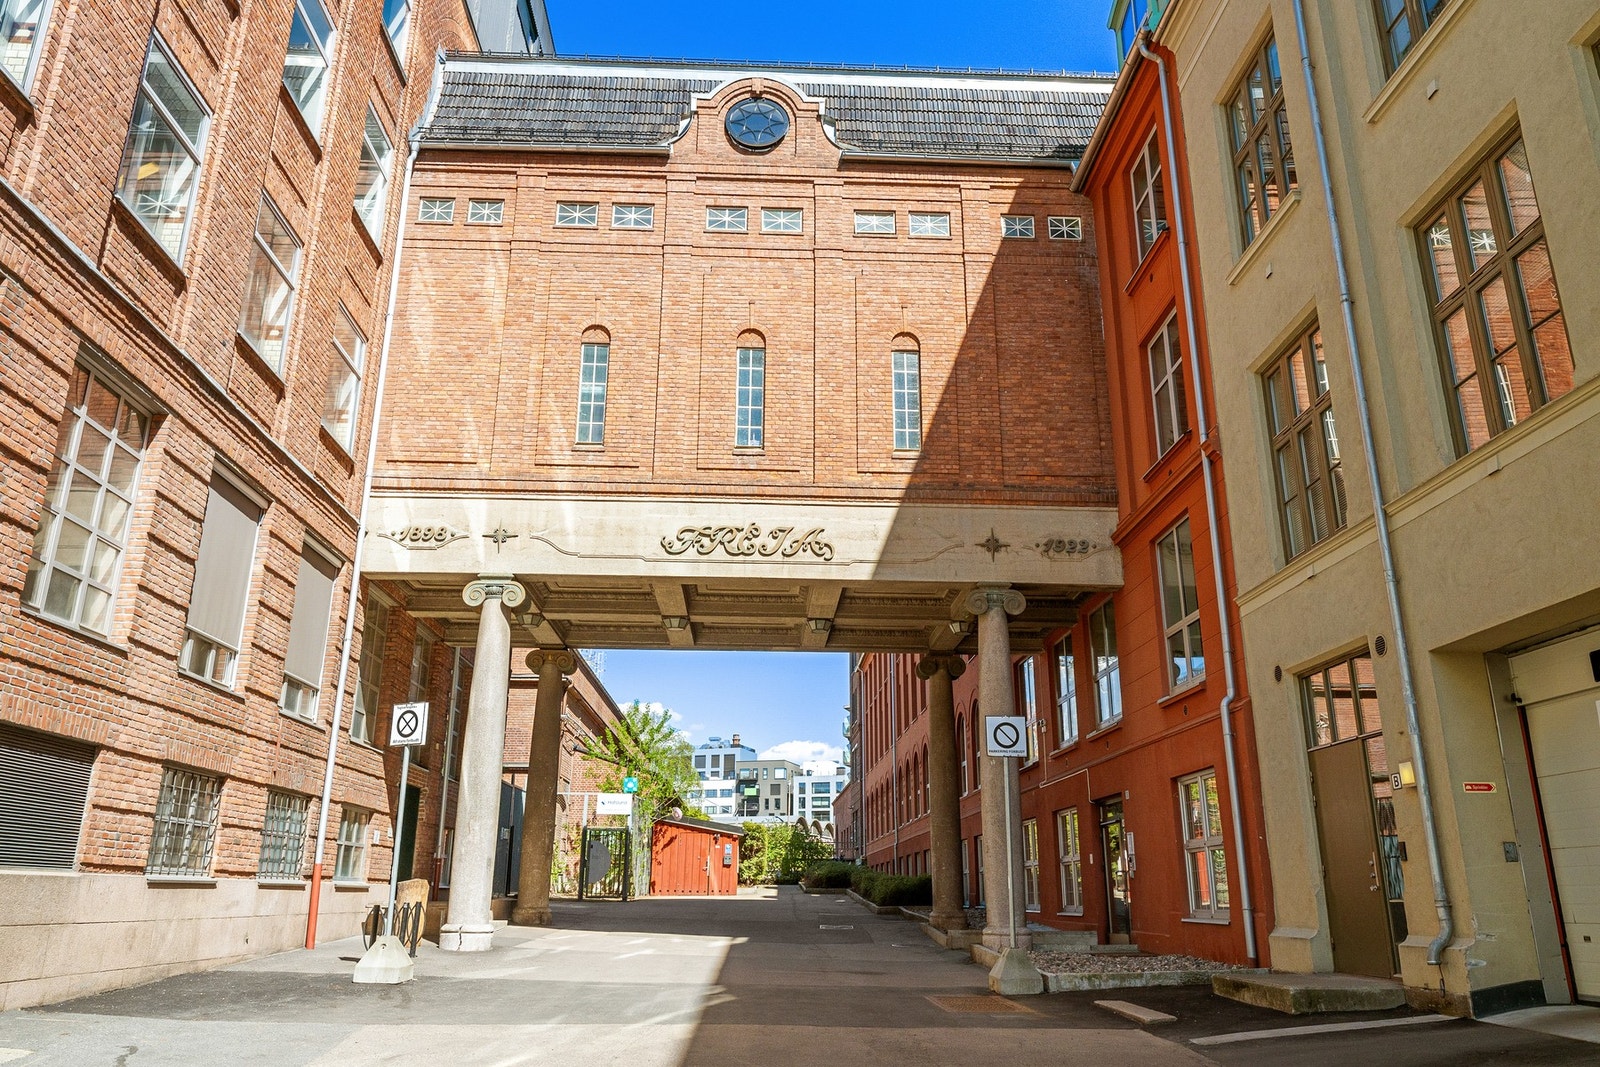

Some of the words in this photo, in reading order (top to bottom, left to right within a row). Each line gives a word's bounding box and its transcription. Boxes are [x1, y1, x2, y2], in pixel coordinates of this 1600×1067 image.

[400, 525, 448, 543] 1898
[660, 522, 835, 561] FREIA
[1042, 537, 1090, 554] 1922
[1393, 775, 1399, 787] B
